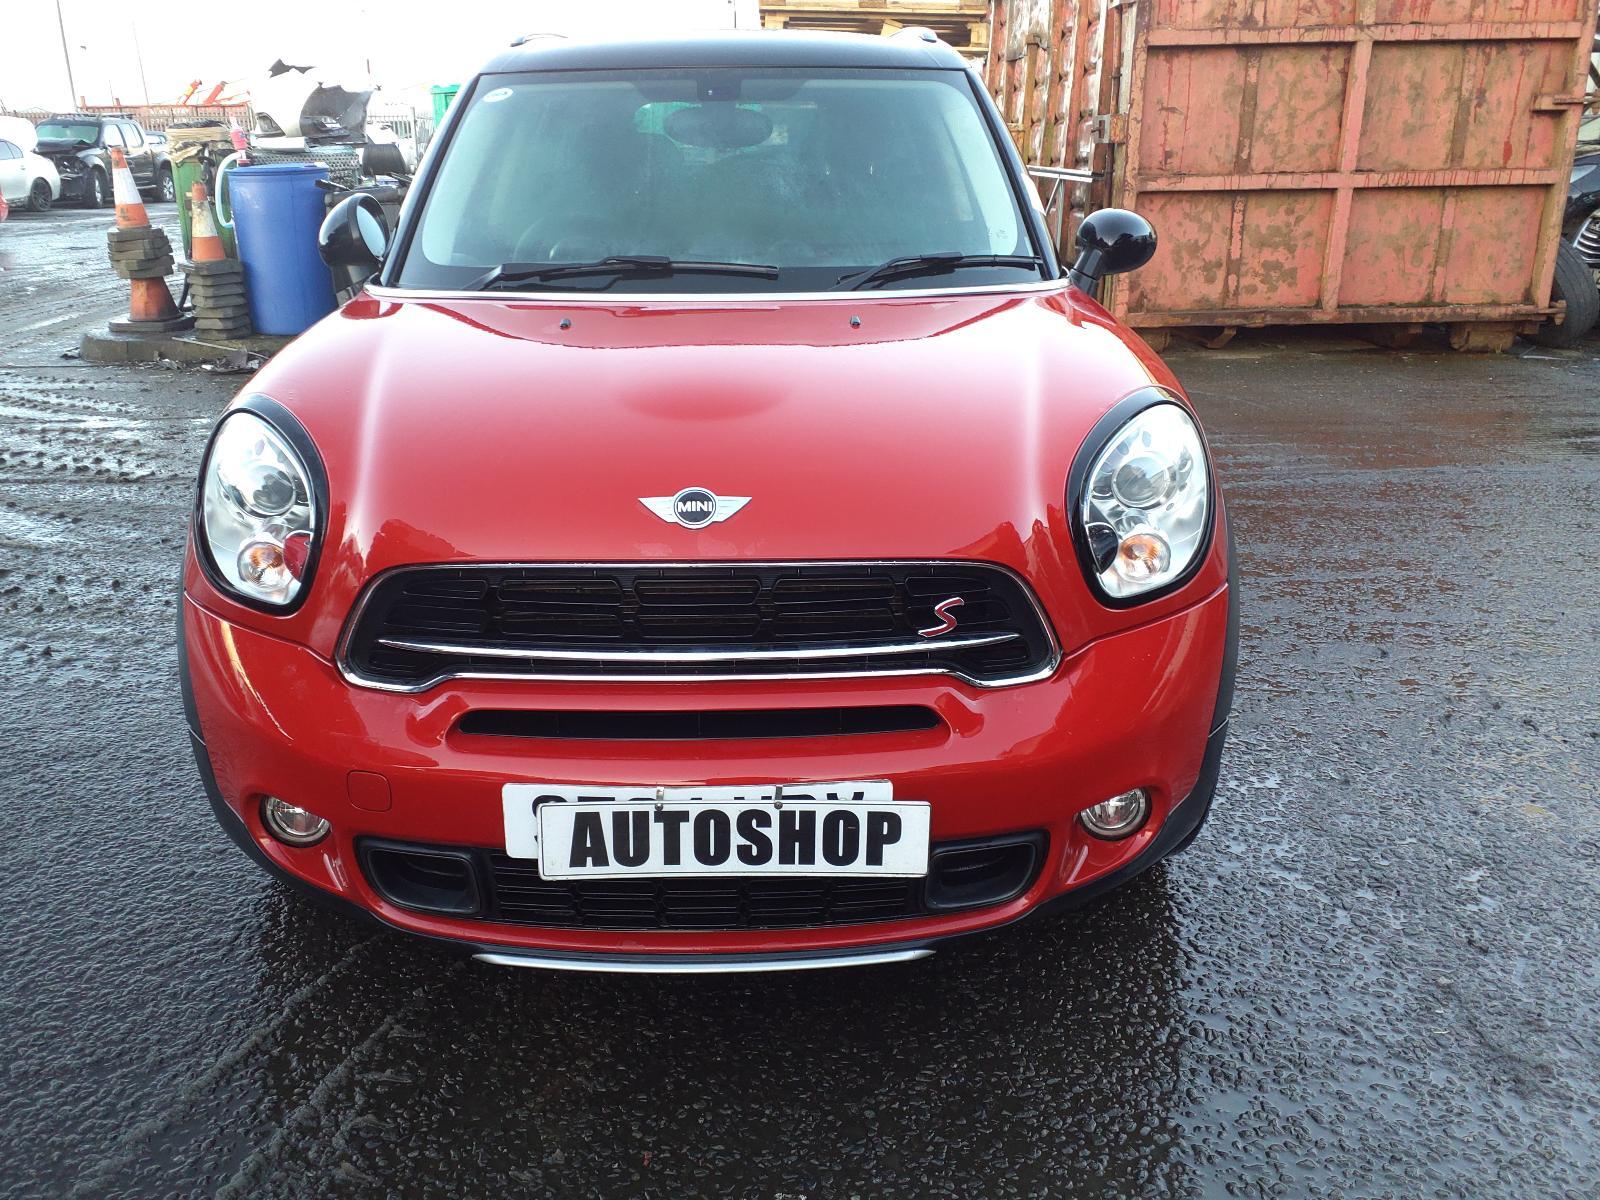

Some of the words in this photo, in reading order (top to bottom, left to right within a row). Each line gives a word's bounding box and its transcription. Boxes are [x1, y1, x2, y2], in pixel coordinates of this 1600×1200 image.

[677, 501, 713, 513] MINI
[918, 597, 964, 637] S
[569, 808, 902, 867] AUTOSHOP
